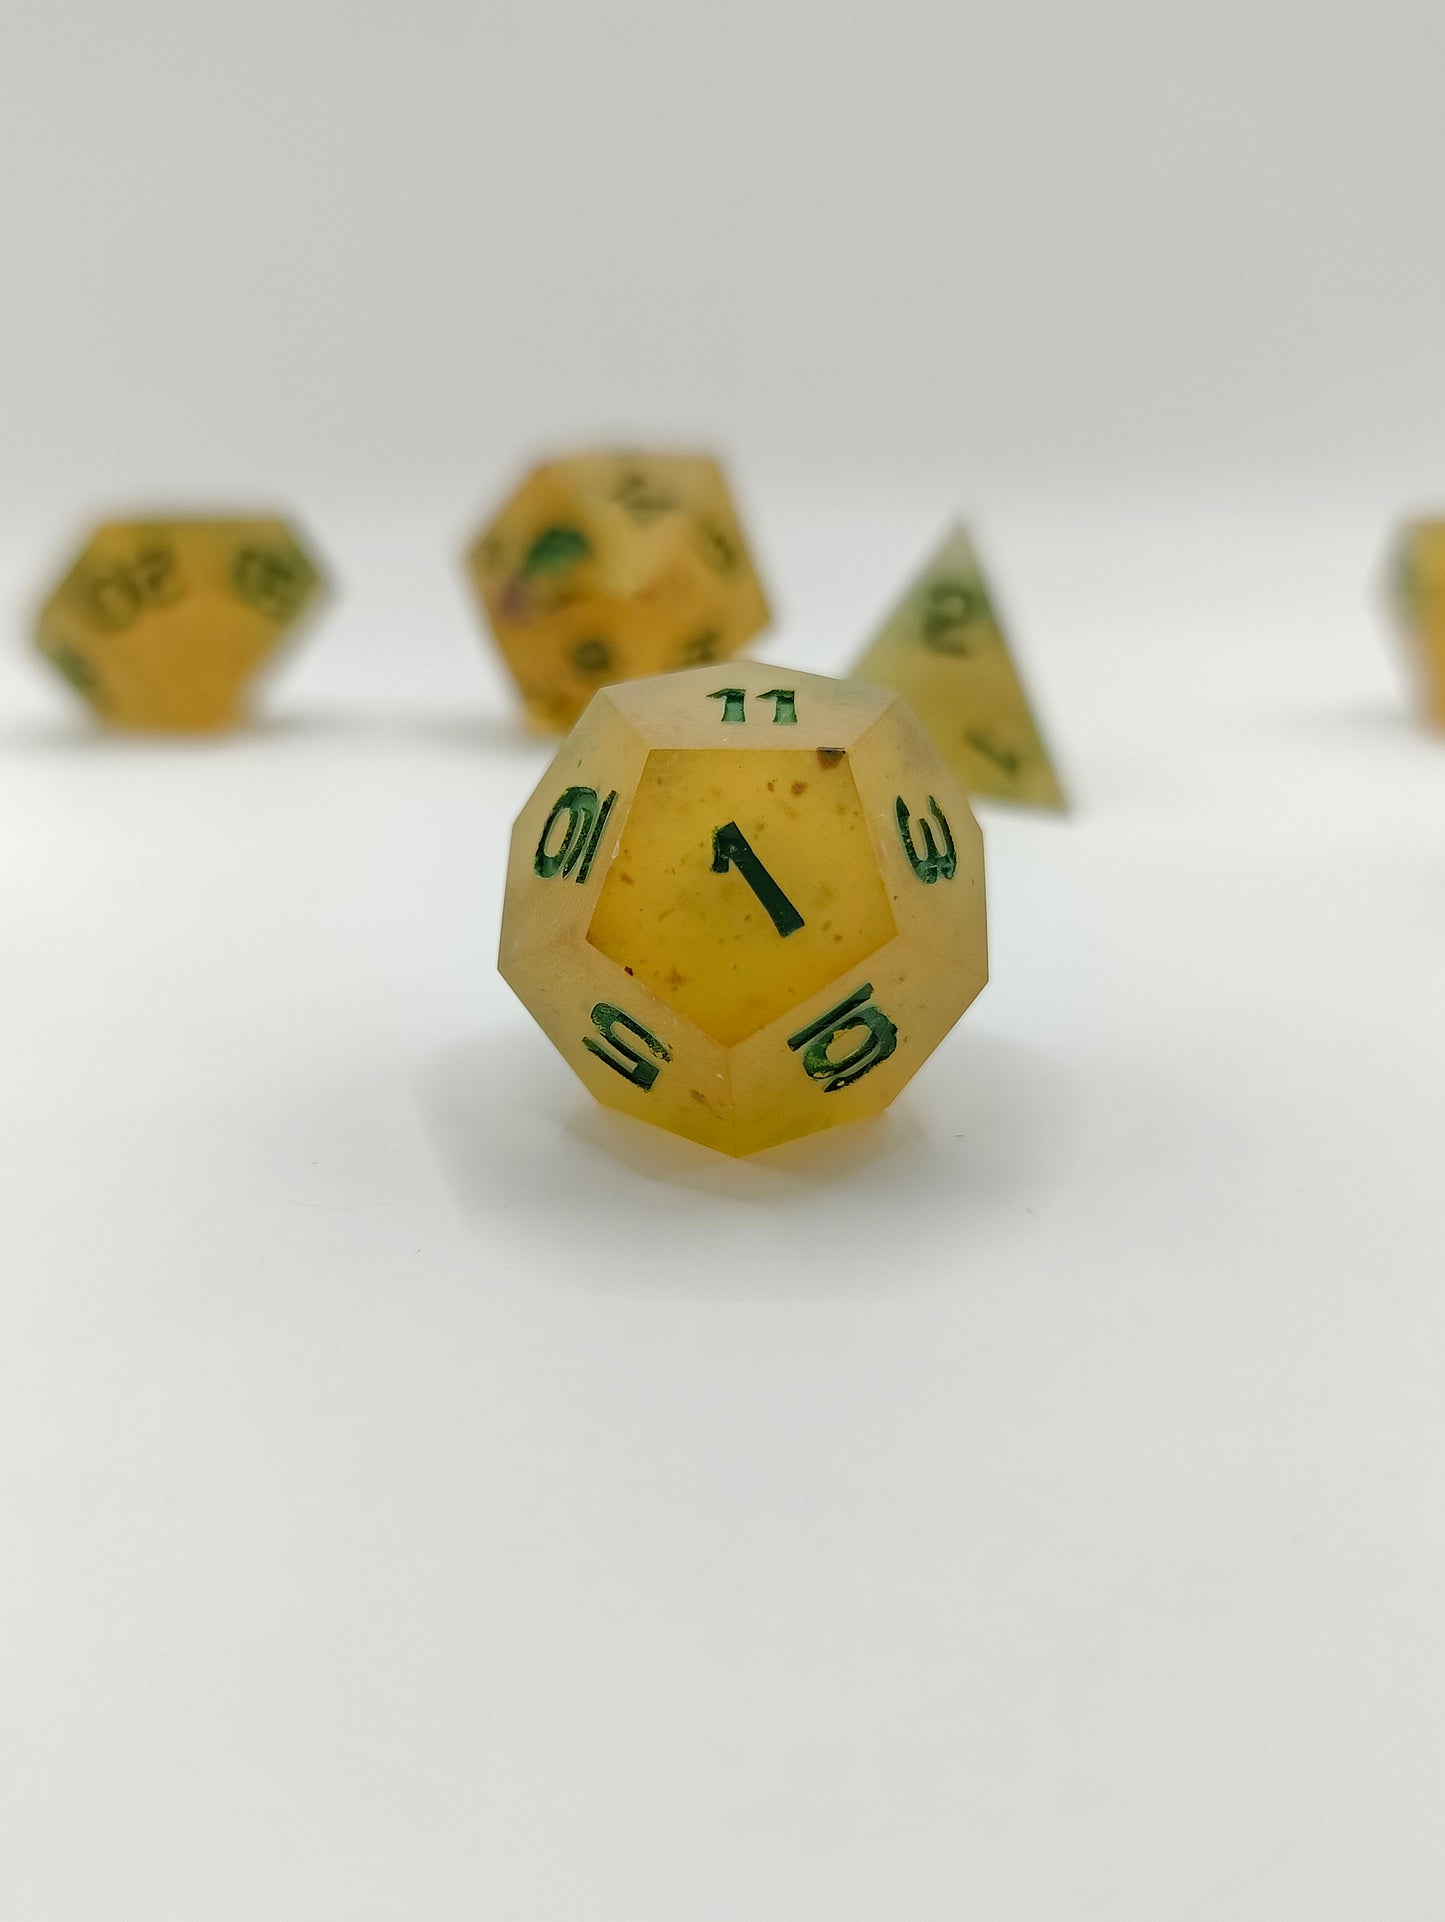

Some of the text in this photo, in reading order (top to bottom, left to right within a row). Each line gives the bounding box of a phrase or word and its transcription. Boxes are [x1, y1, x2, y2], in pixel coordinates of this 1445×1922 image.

[921, 578, 976, 658] 2
[705, 687, 798, 724] 11
[709, 820, 806, 939] 1
[894, 794, 958, 886] 3
[581, 1001, 673, 1093] 5
